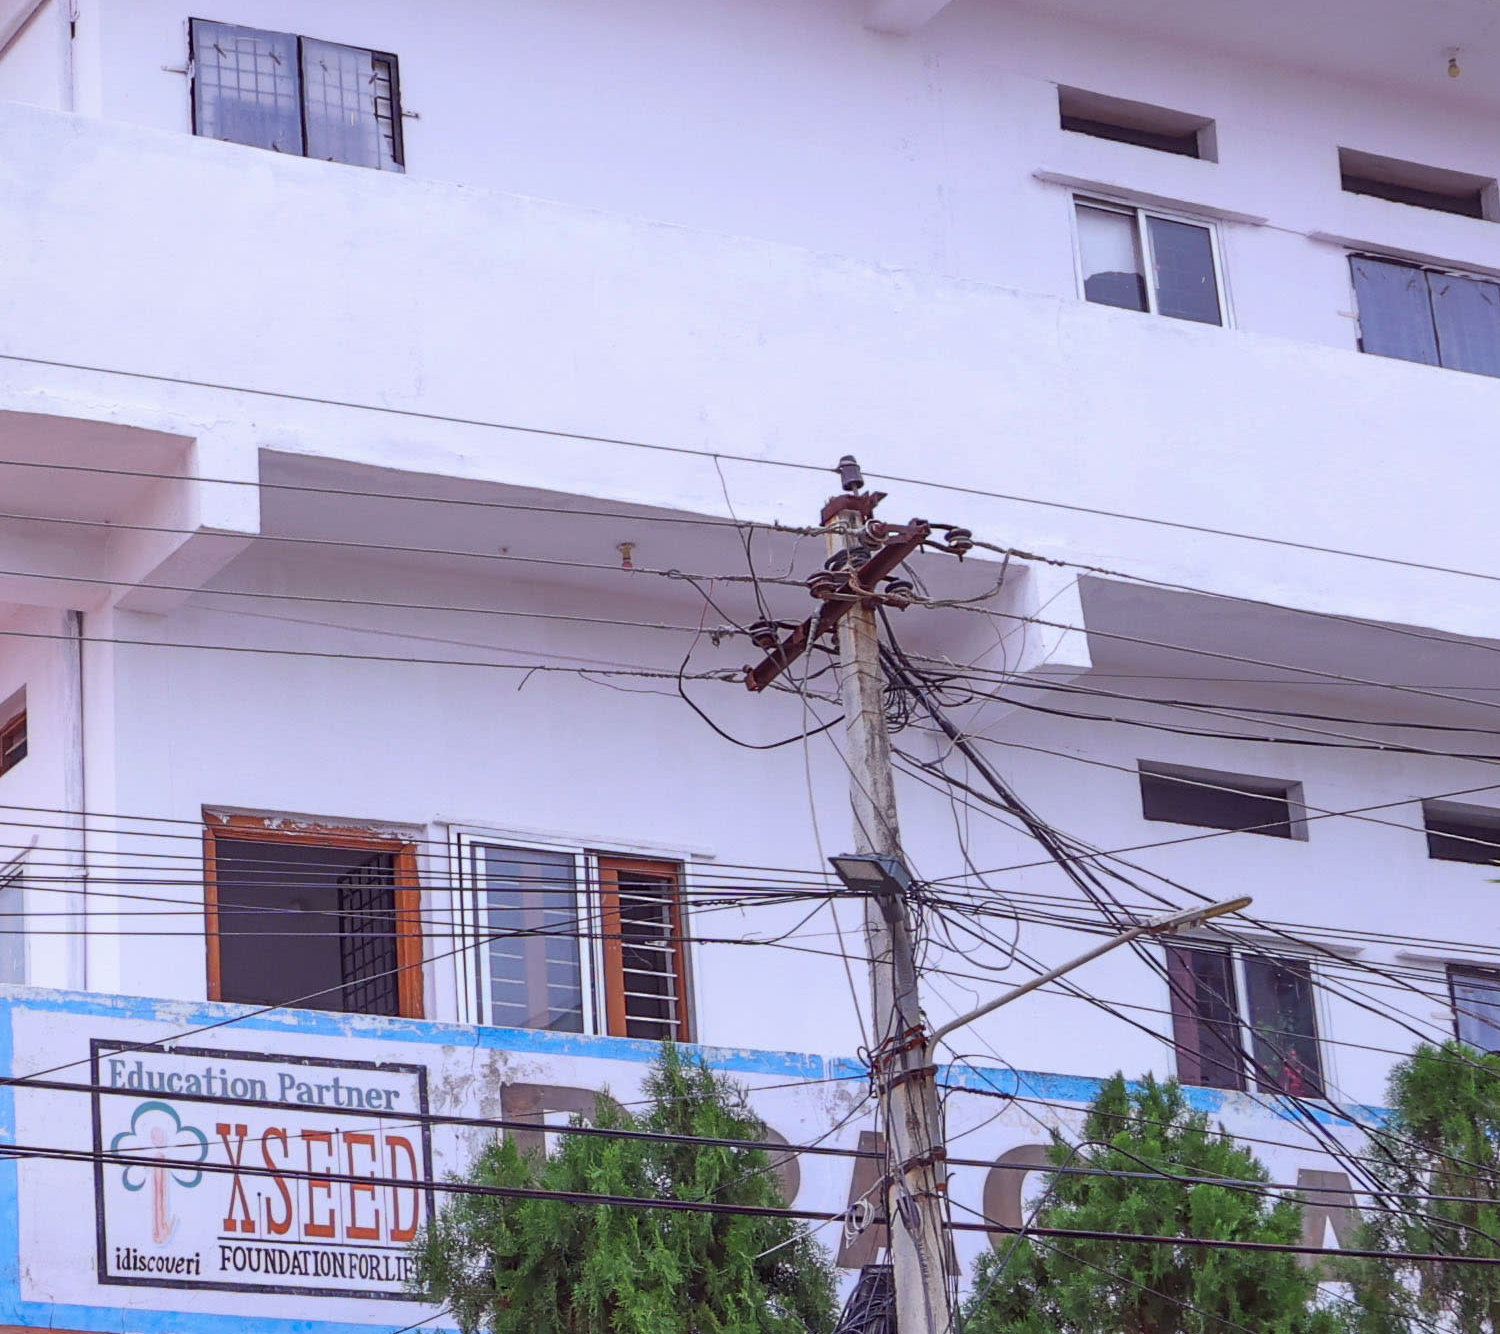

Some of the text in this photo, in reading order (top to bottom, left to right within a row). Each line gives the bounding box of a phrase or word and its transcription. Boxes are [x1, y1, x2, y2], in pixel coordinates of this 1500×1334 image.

[108, 1058, 400, 1112] Education Partner
[216, 1122, 421, 1243] XSEED
[115, 1245, 202, 1277] idiscoveri
